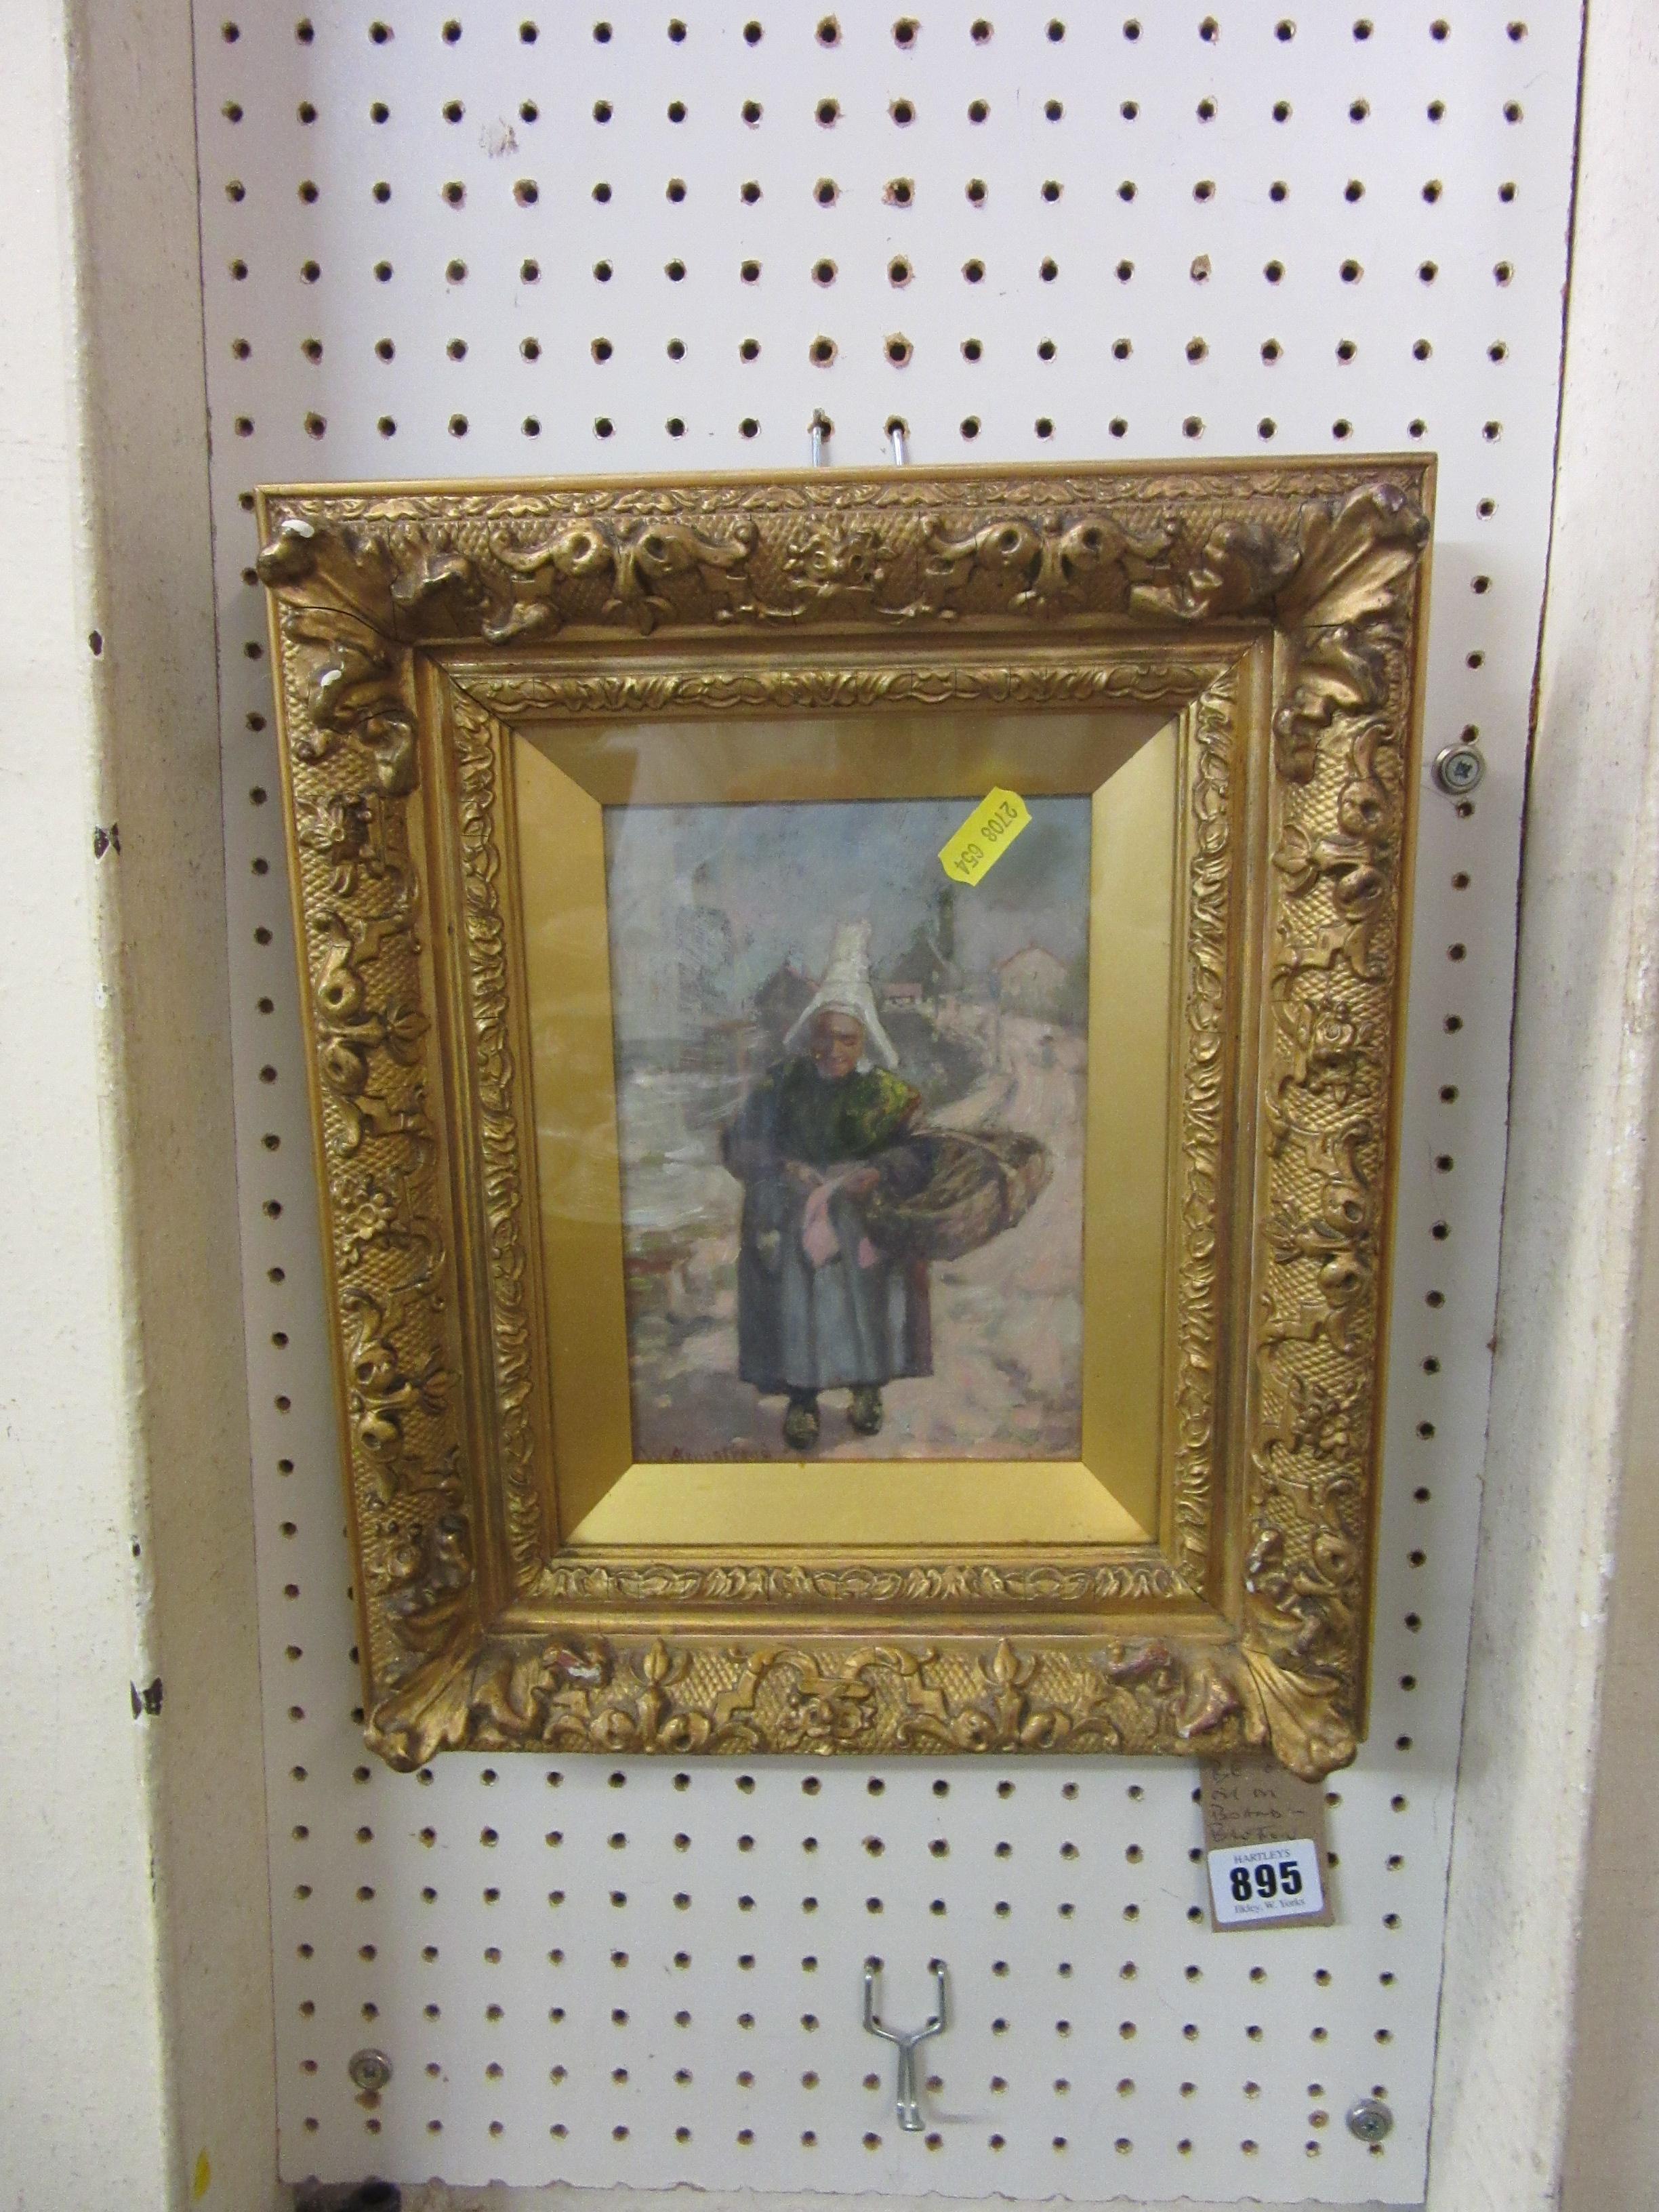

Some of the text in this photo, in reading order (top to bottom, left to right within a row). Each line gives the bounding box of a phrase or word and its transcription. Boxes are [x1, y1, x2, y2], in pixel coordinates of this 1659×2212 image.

[954, 801, 1018, 875] 2708 654
[1229, 1860, 1303, 1902] 895
